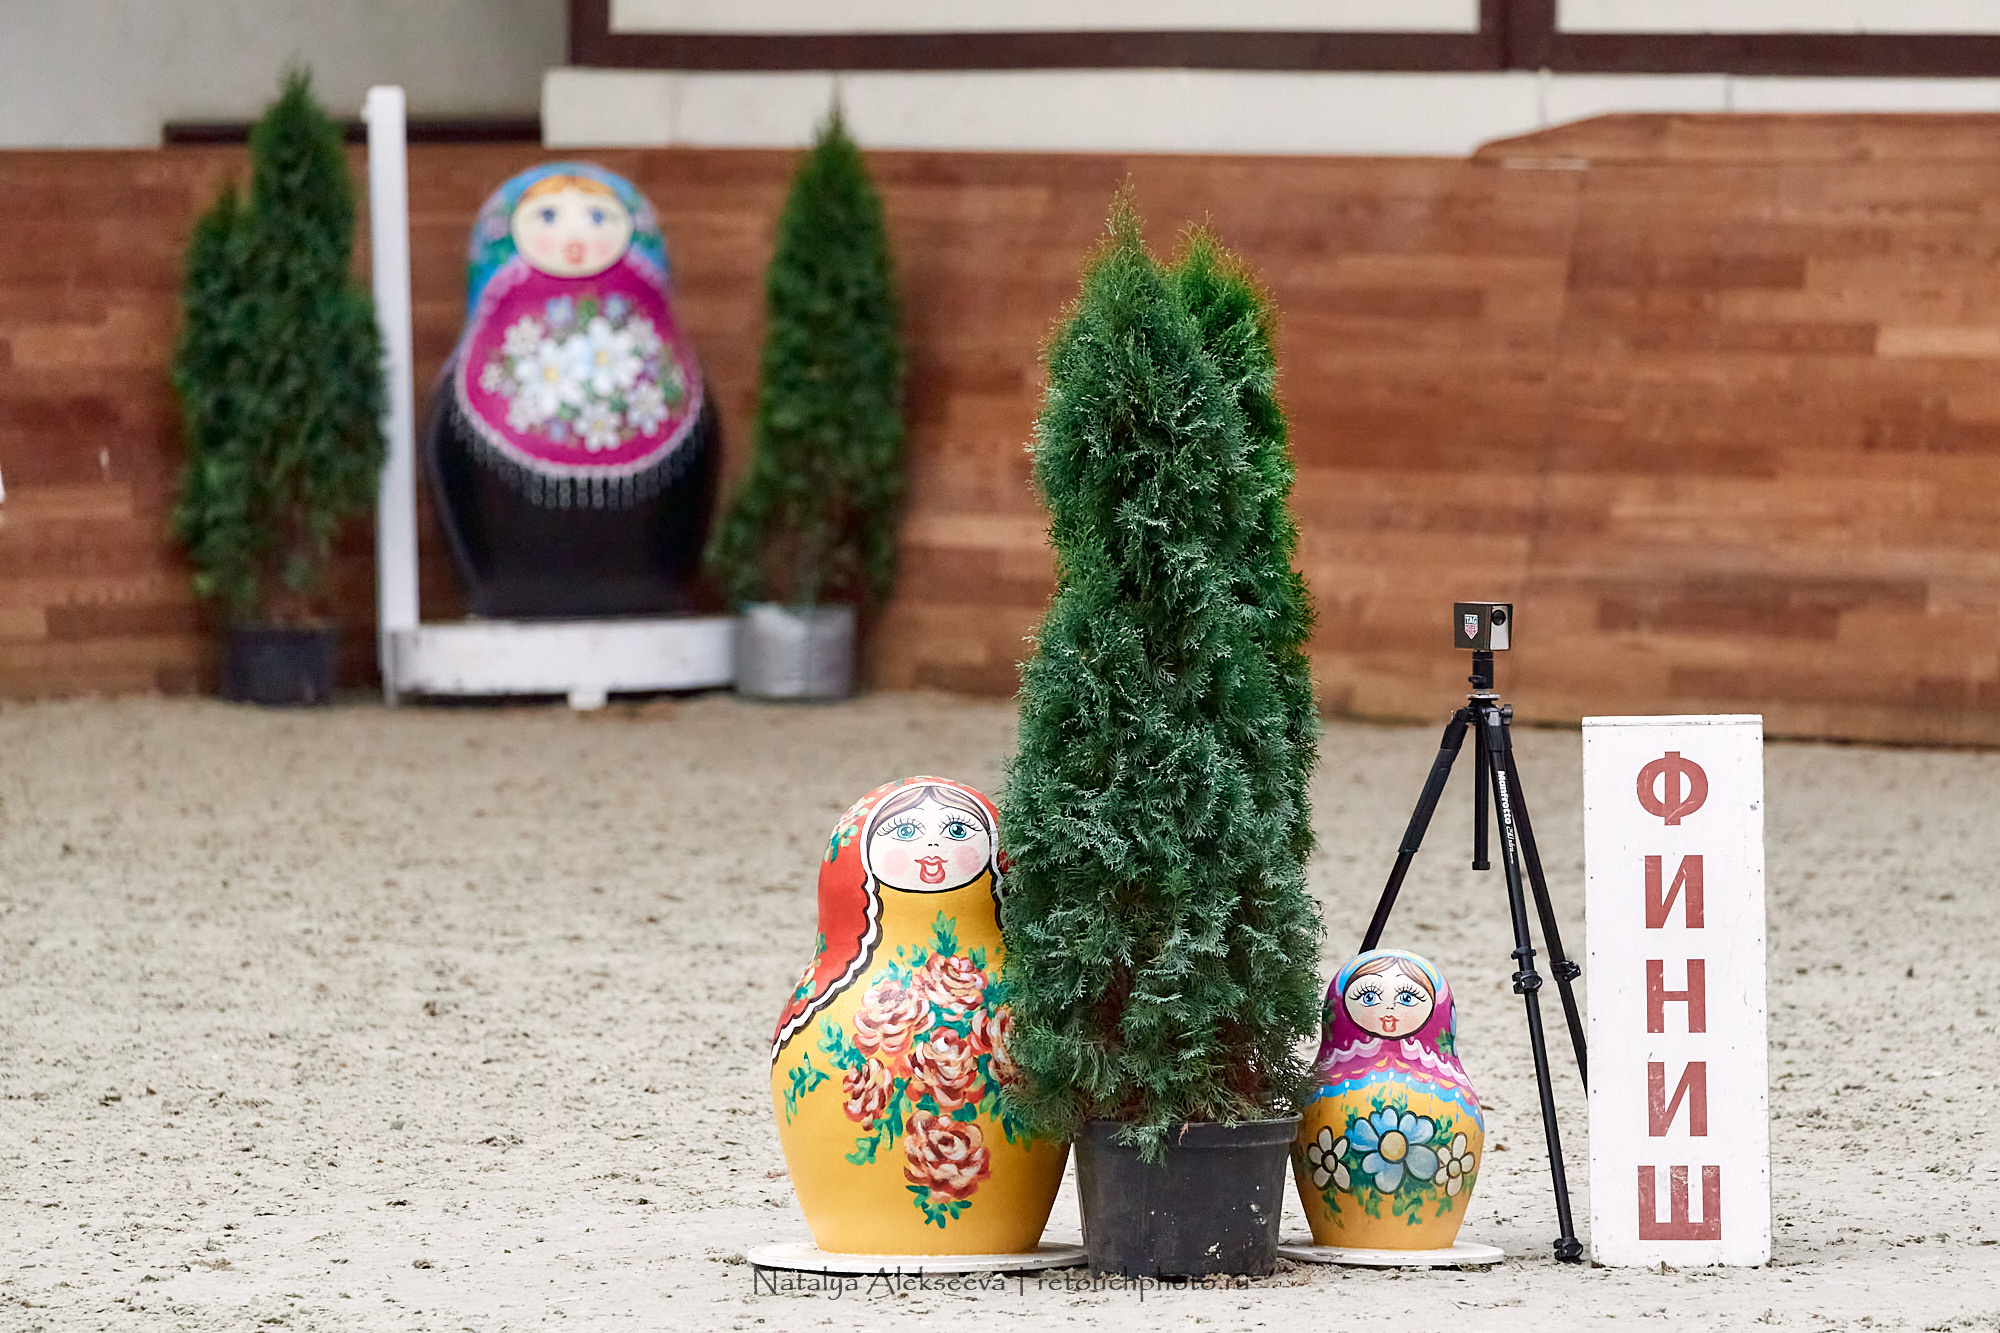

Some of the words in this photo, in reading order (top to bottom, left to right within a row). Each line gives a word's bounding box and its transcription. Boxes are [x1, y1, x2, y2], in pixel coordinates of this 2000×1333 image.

[1465, 616, 1478, 625] TAG
[1497, 770, 1512, 824] Manfrotto
[1636, 751, 1721, 1240] ФИНИШ
